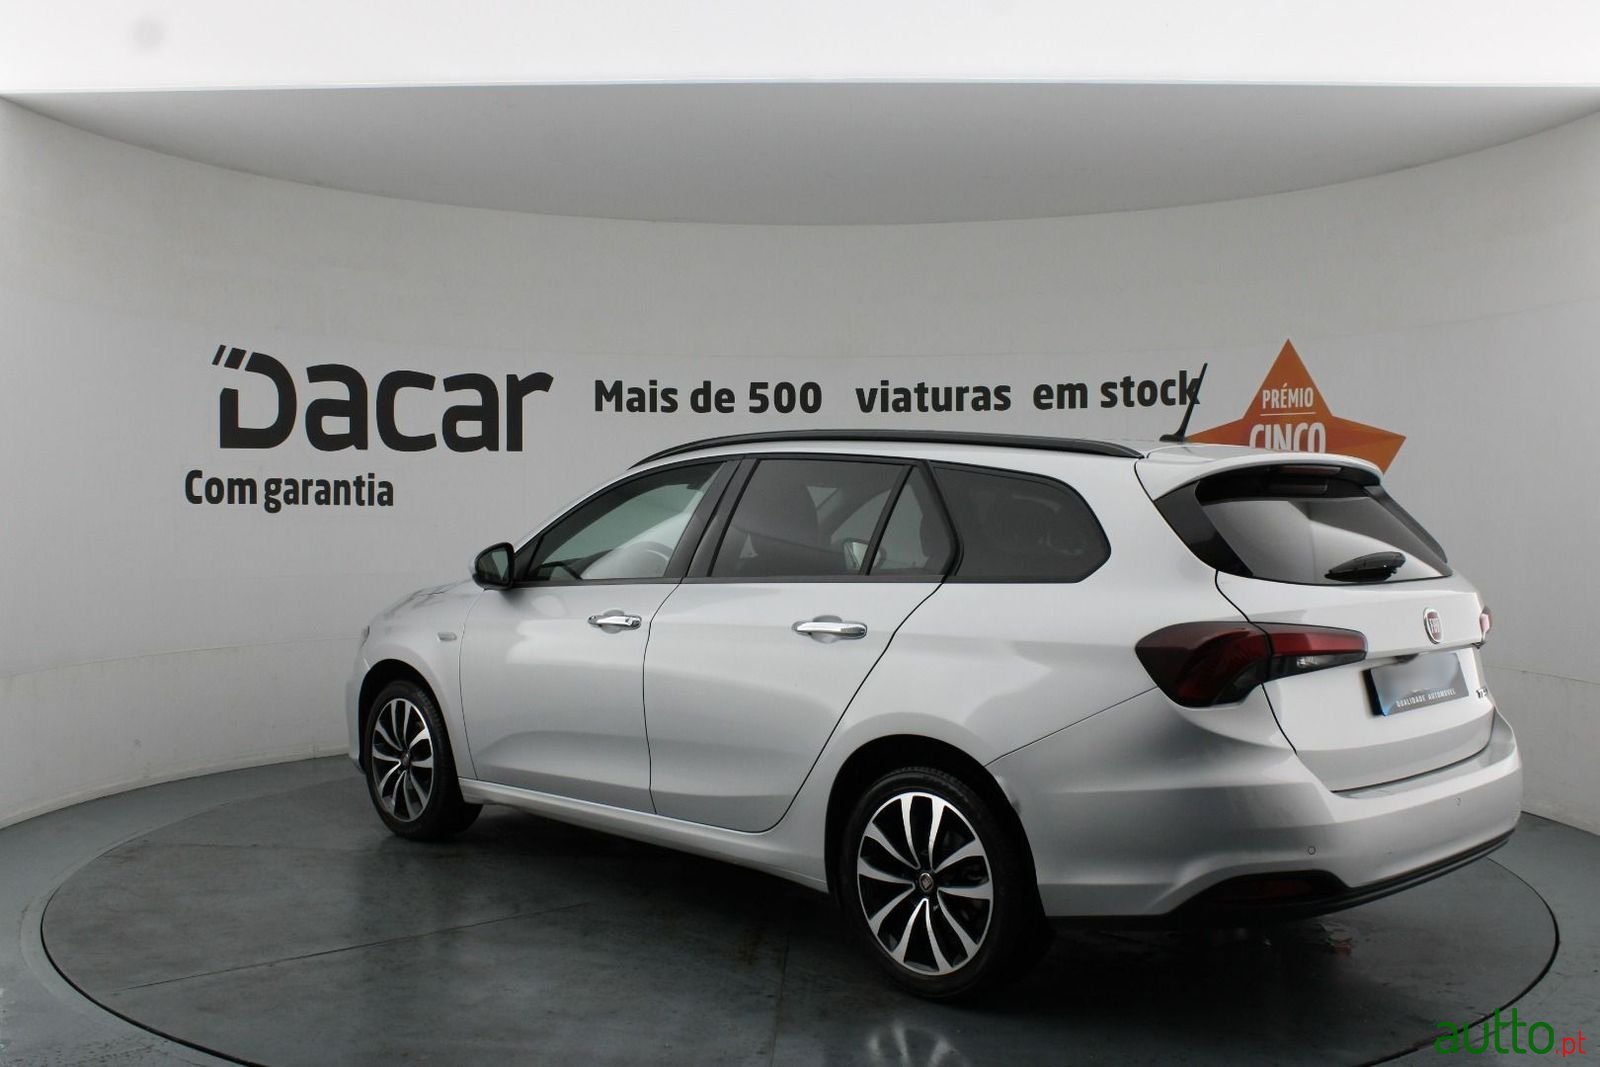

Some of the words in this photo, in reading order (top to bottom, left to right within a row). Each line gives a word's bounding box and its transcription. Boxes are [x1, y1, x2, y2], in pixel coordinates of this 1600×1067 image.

[211, 344, 554, 453] Dacar
[594, 379, 679, 414] Mais
[689, 380, 736, 414] de
[748, 381, 823, 414] 500
[855, 379, 1012, 414] viaturas
[1032, 382, 1088, 411] em
[1100, 370, 1201, 408] stock
[1262, 382, 1314, 409] PRÉMIO
[1249, 422, 1326, 454] CINCO
[184, 469, 258, 505] Com
[263, 472, 394, 514] garantia
